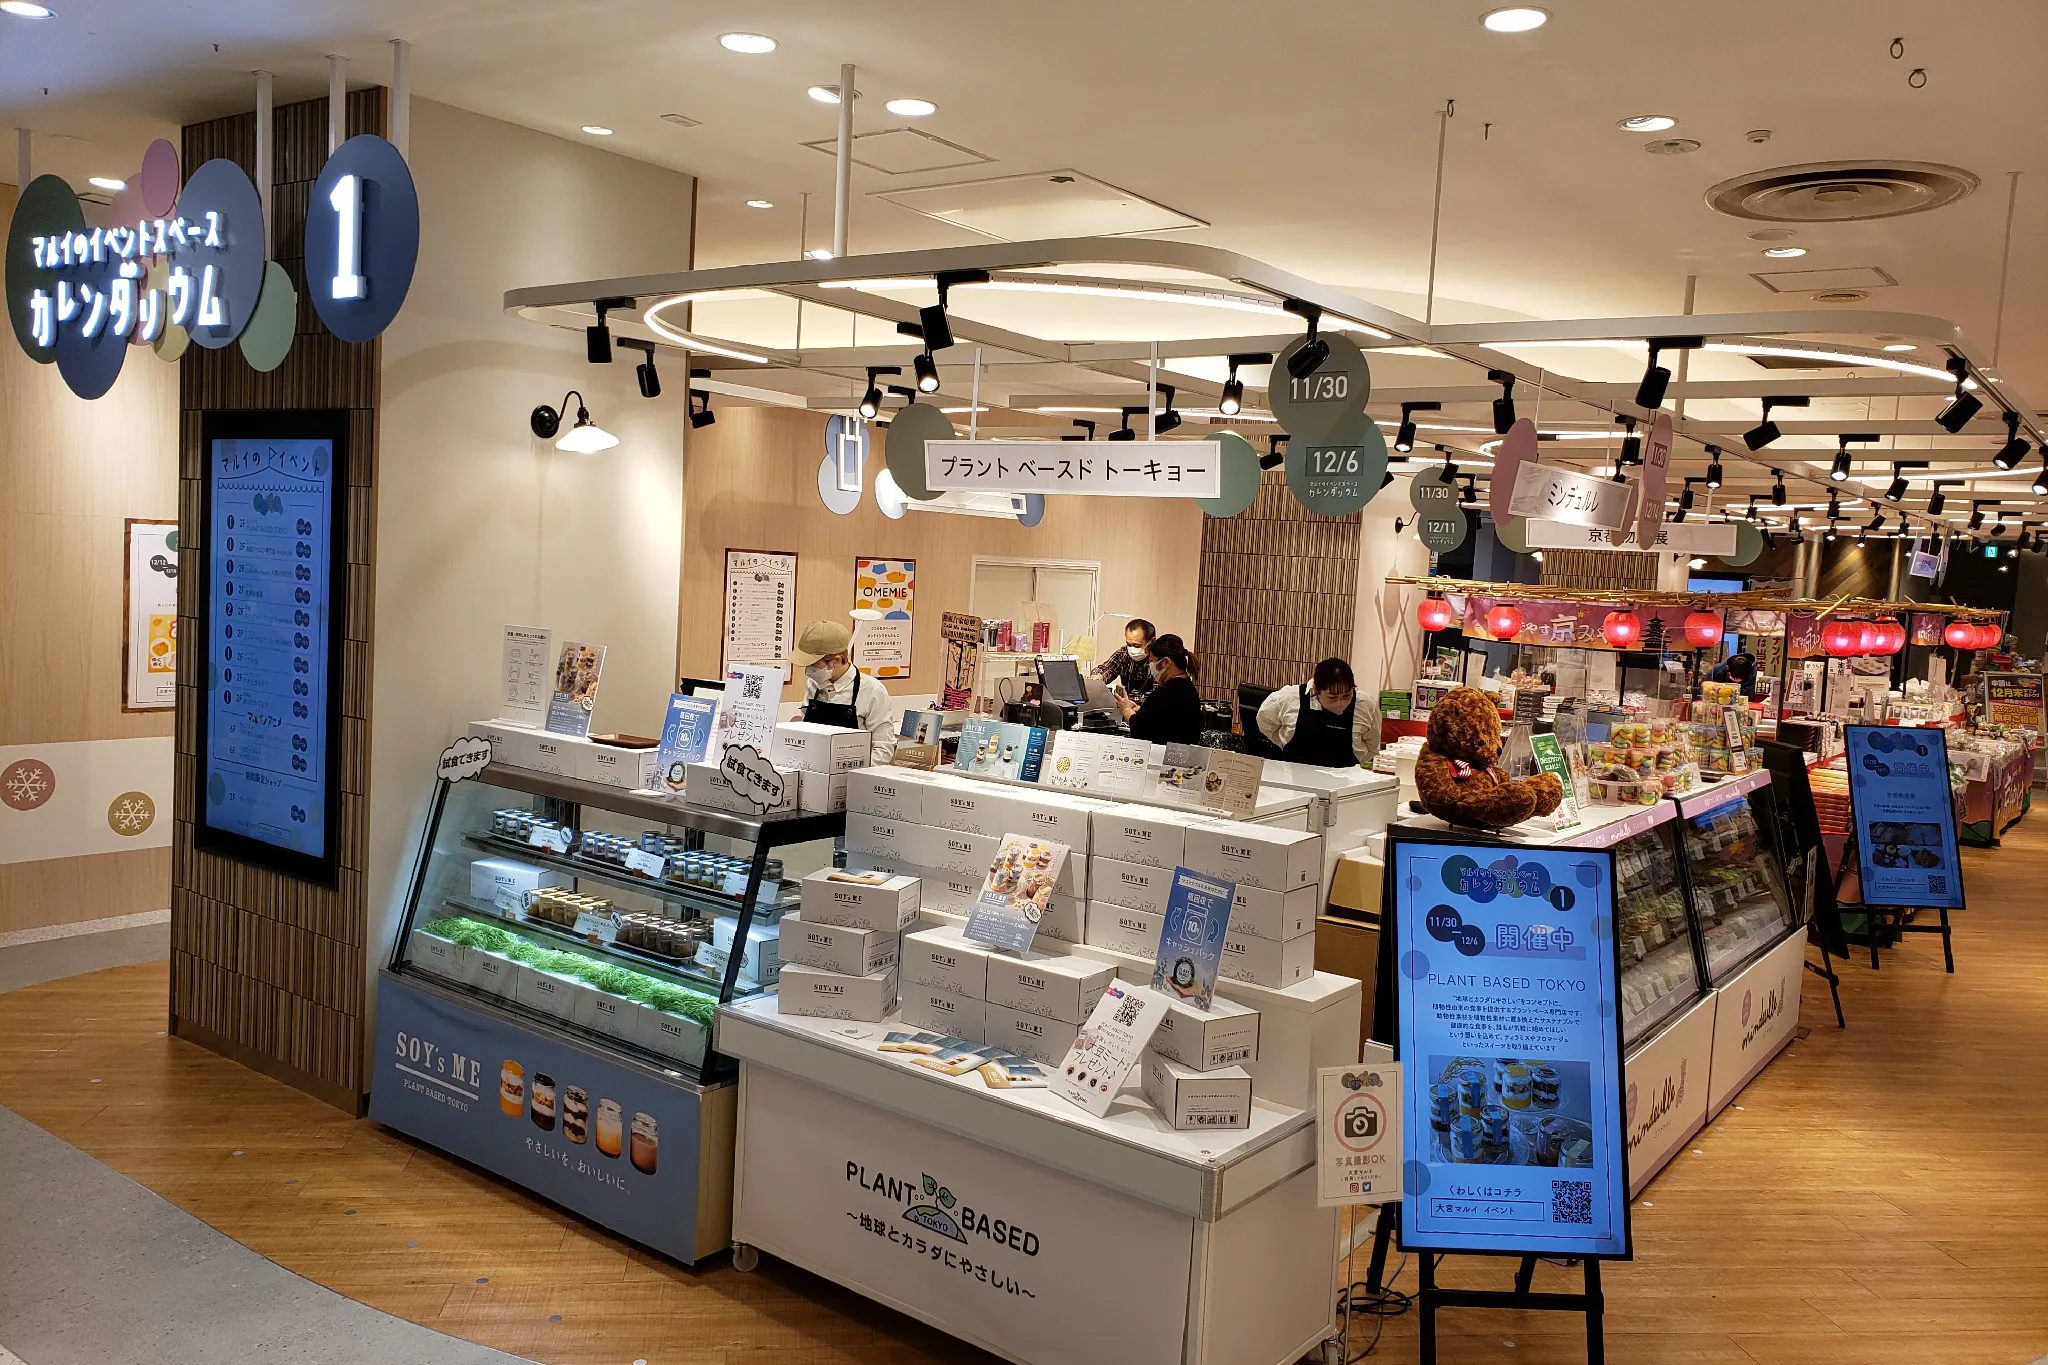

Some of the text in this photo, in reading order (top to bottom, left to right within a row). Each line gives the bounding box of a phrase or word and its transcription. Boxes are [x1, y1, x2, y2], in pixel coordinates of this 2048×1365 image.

[32, 211, 225, 266] マルイのイベントスペース
[330, 174, 365, 299] 1
[30, 261, 228, 347] カレンダリウム
[1291, 375, 1348, 400] 11/30
[222, 450, 320, 477] マルイの イベント
[1313, 450, 1359, 473] 12/6
[941, 457, 1206, 483] プラント ベースド トーキョー
[1308, 486, 1358, 498] カレンダリウム
[1420, 487, 1448, 499] 11/30
[1428, 522, 1455, 534] 12/11
[863, 586, 907, 598] OMEMIE
[442, 749, 488, 769] 試食できます
[1893, 762, 1930, 775] 開催中
[727, 755, 781, 797] 試食できます
[1124, 827, 1140, 835] SOY's
[1221, 844, 1251, 856] SOY's ME
[1121, 873, 1149, 884] SOY's ME
[1459, 878, 1540, 894] カレンダリウム
[834, 892, 863, 903] SOY's ME
[1119, 918, 1136, 927] SOY's
[1430, 917, 1457, 928] 11/30
[1461, 936, 1478, 946] 12/6
[1496, 924, 1574, 952] 開催中
[1165, 936, 1215, 960] キャッシュバック
[932, 953, 956, 965] SOY's ME
[1018, 975, 1045, 987] SOY's ME
[1428, 974, 1586, 992] PLANT BASED TOKYO
[814, 984, 844, 994] SOY's ME
[930, 997, 955, 1009] SOY's ME
[1016, 1021, 1043, 1034] SOY's ME
[396, 1031, 480, 1088] SOY's ME
[404, 1078, 468, 1112] PLANT BASED TOKYO
[525, 1136, 631, 1194] やさしいを、おいしいに。
[1336, 1154, 1386, 1167] 写真撮影OK
[1448, 1185, 1522, 1198] くわしくはコチラ
[846, 1160, 1040, 1257] PLANT BASED
[1436, 1204, 1515, 1216] 大宮マルイ イベント
[922, 1215, 949, 1232] TOKYO
